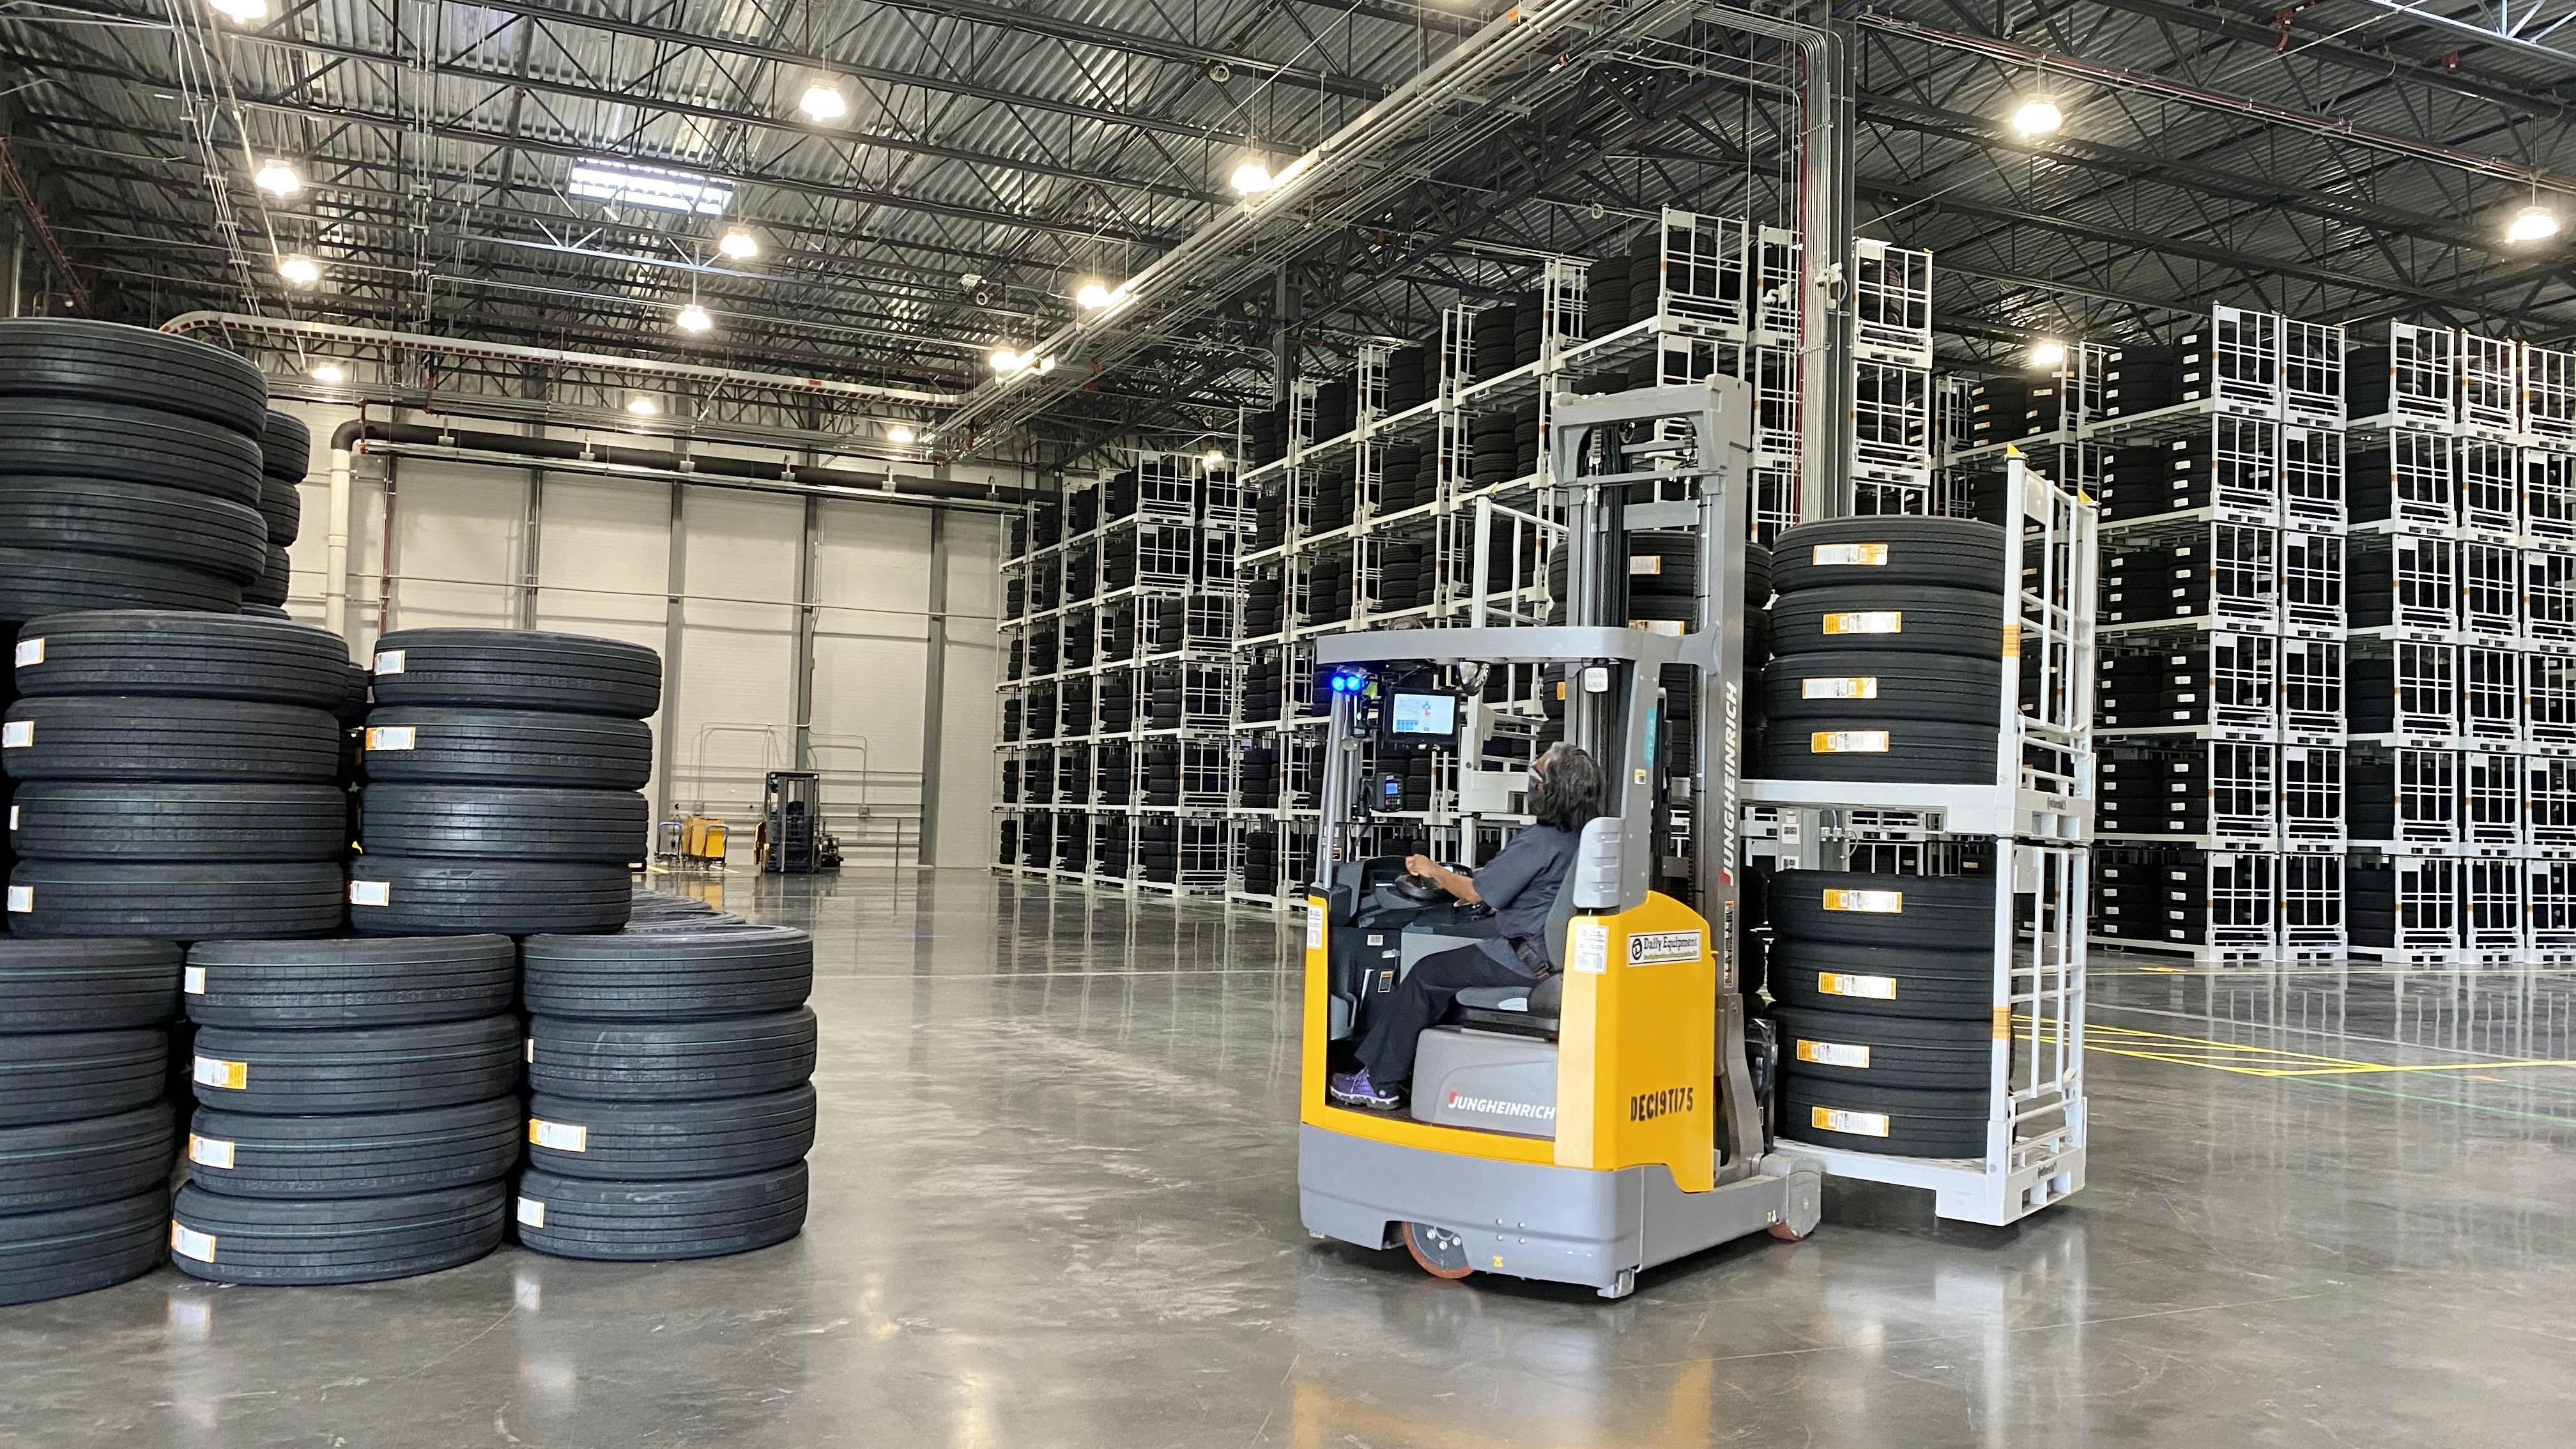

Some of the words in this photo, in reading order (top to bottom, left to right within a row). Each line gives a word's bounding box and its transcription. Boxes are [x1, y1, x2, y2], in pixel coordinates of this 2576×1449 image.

[1719, 680, 1738, 887] JUNGHEINRICH
[1644, 937, 1662, 951] Daily
[1663, 935, 1698, 951] Equipment
[1448, 1090, 1556, 1120] JUNGHEINRICH
